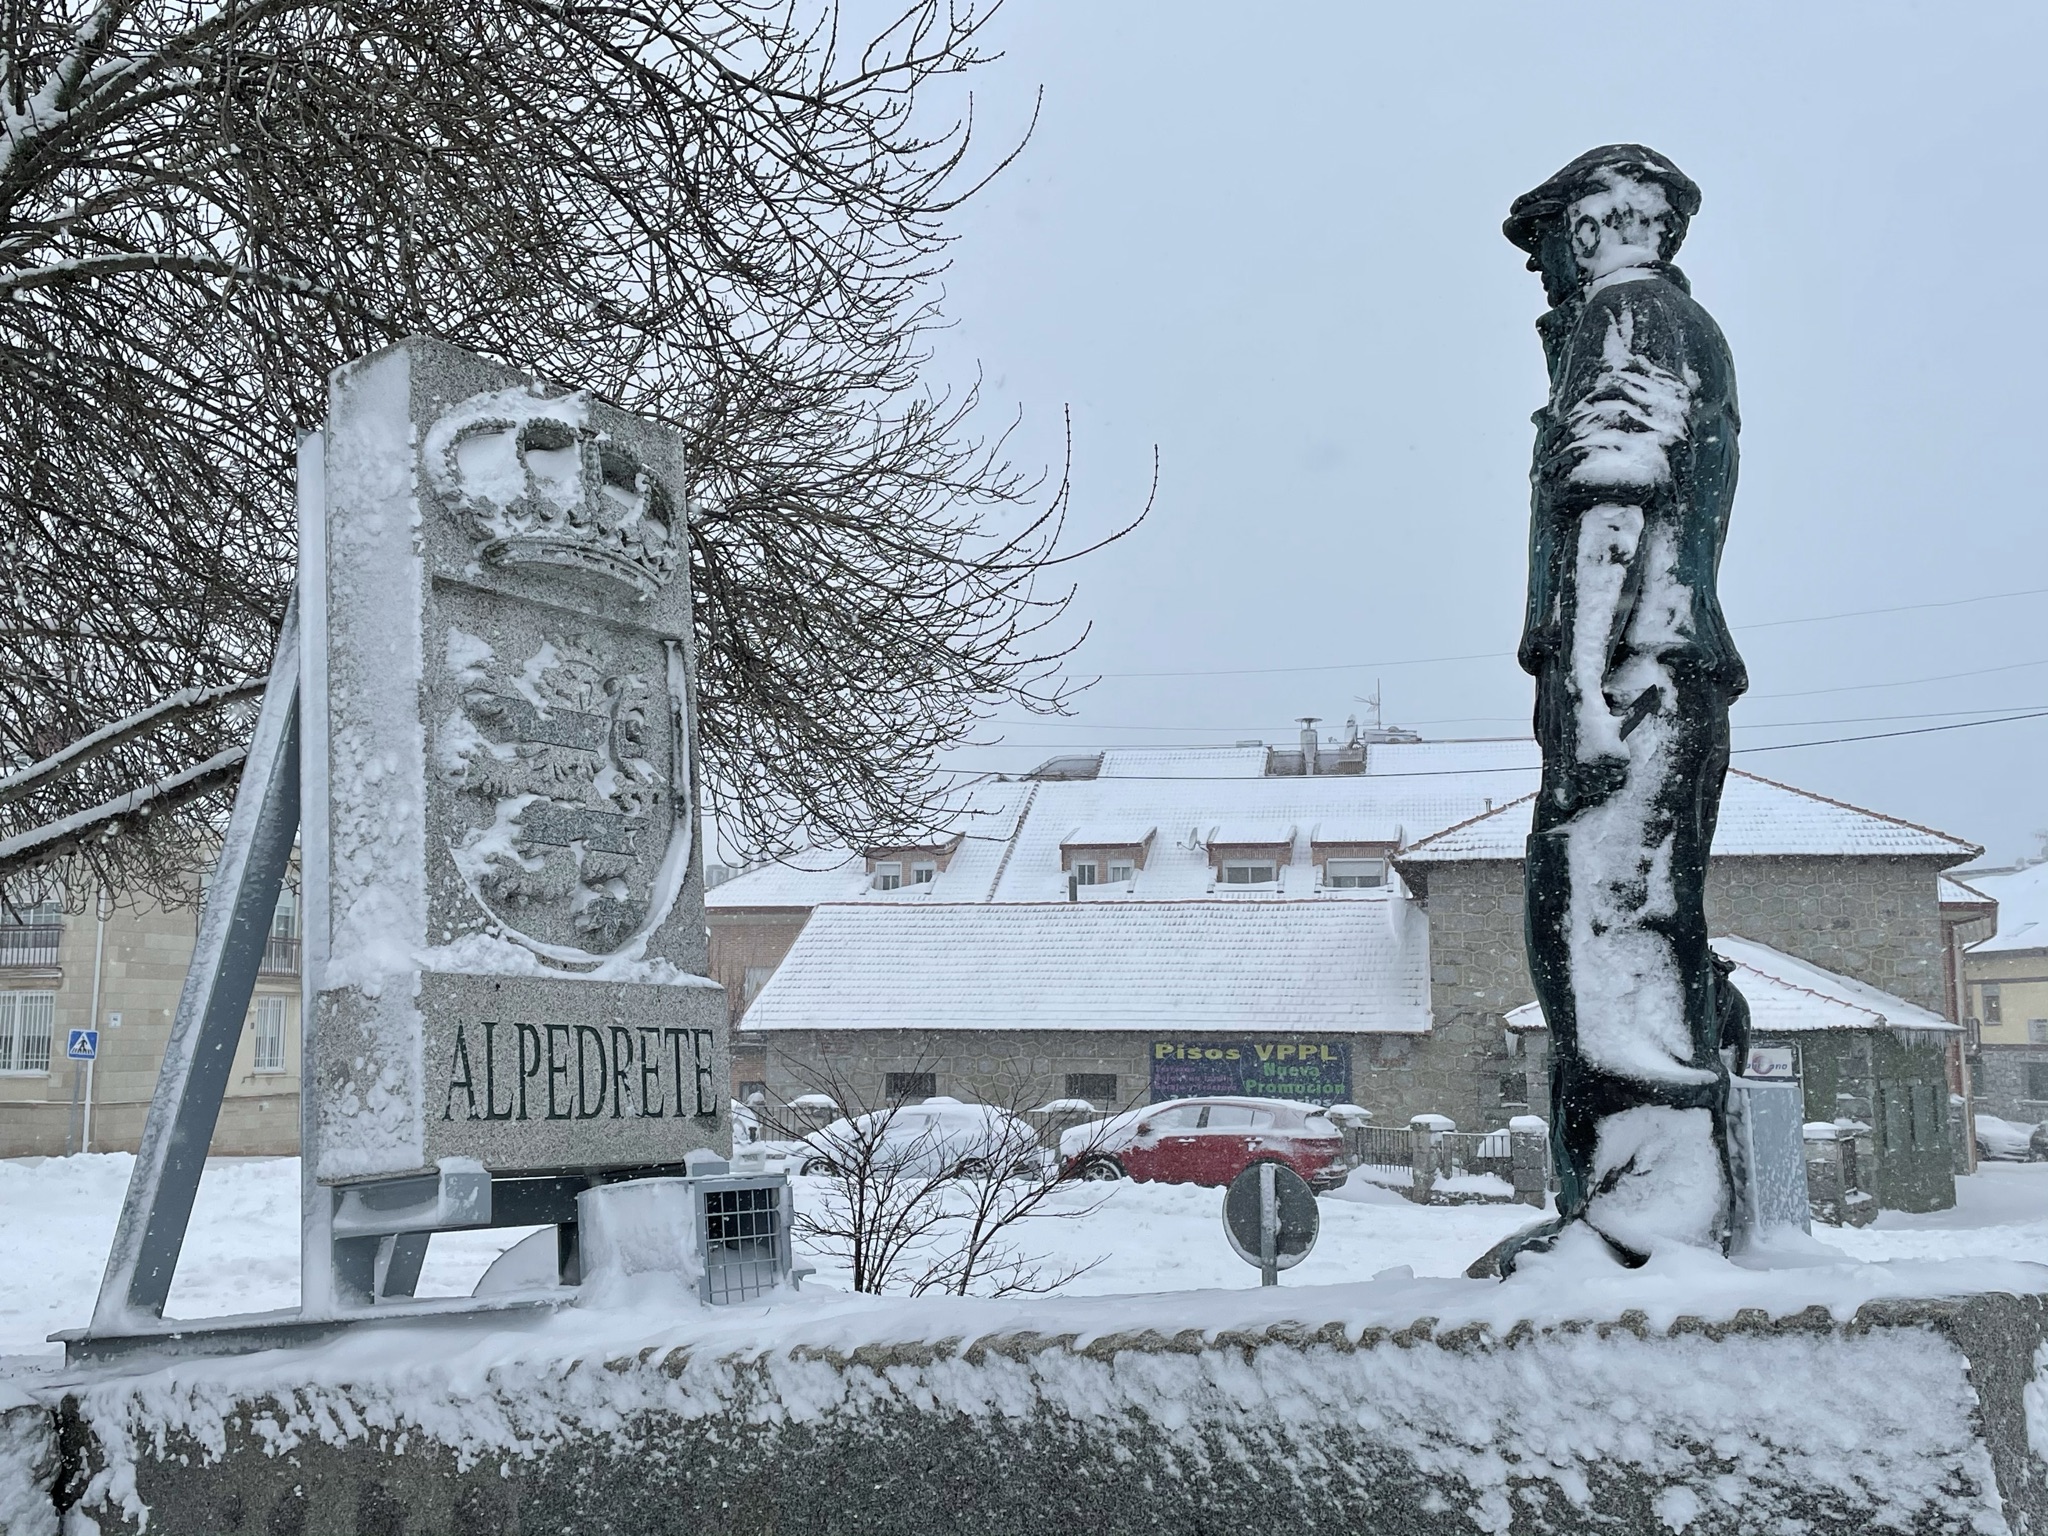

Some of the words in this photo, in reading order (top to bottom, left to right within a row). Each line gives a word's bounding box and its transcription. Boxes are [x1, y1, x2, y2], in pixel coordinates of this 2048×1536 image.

[1155, 1043, 1241, 1060] Pisos
[1254, 1044, 1338, 1061] VPPL
[442, 1018, 718, 1122] ALPEDRETE
[1263, 1062, 1320, 1077] Nueva
[1245, 1079, 1346, 1094] Promoción
